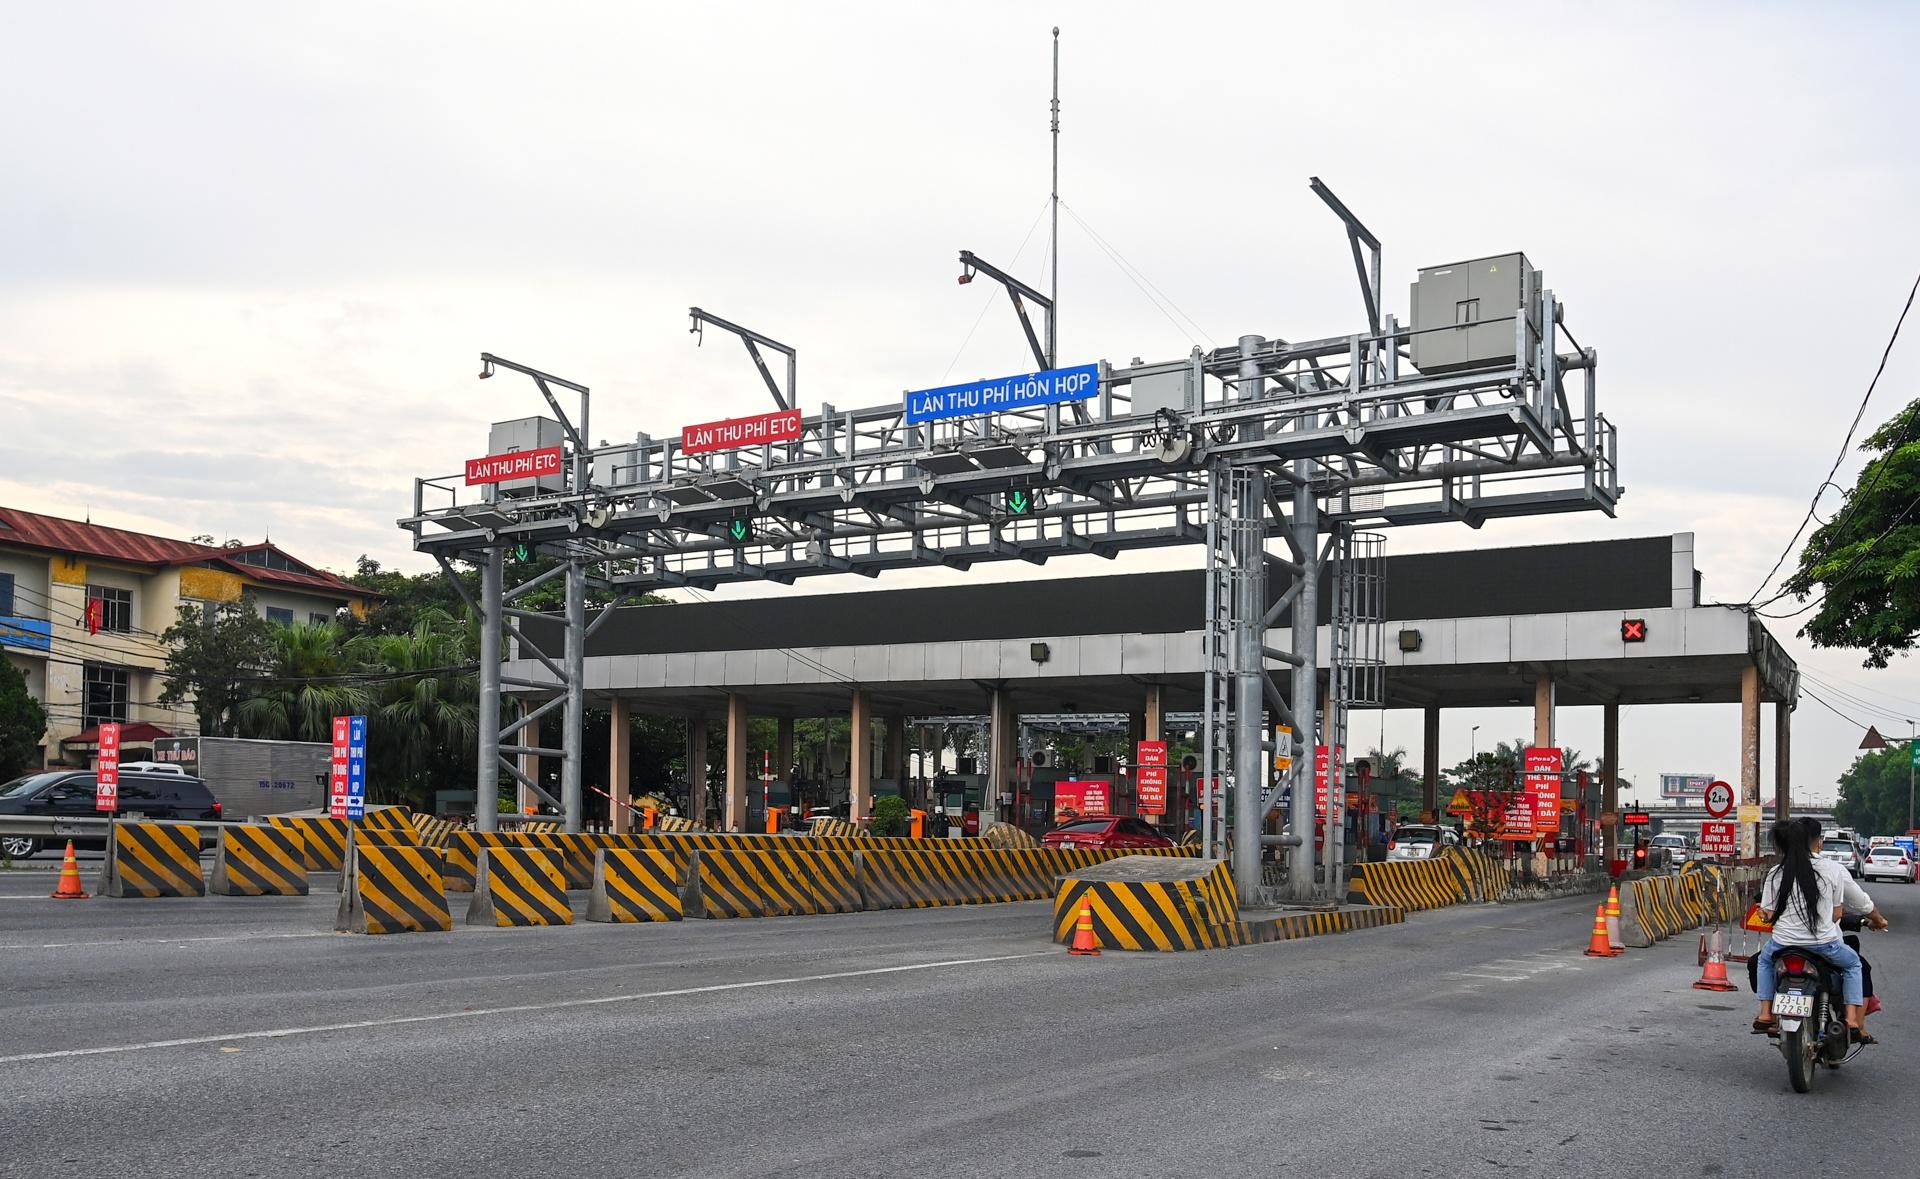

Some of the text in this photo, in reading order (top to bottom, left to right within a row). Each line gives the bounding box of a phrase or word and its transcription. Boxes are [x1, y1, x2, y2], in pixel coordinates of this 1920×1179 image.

[913, 374, 1090, 414] LÀN THU PHÍ HỖN HỢP
[687, 417, 796, 447] LÀN THU PHÍ ETC
[469, 453, 556, 479] LÀN THU PHÍ ETC
[1710, 824, 1725, 833] CẤM
